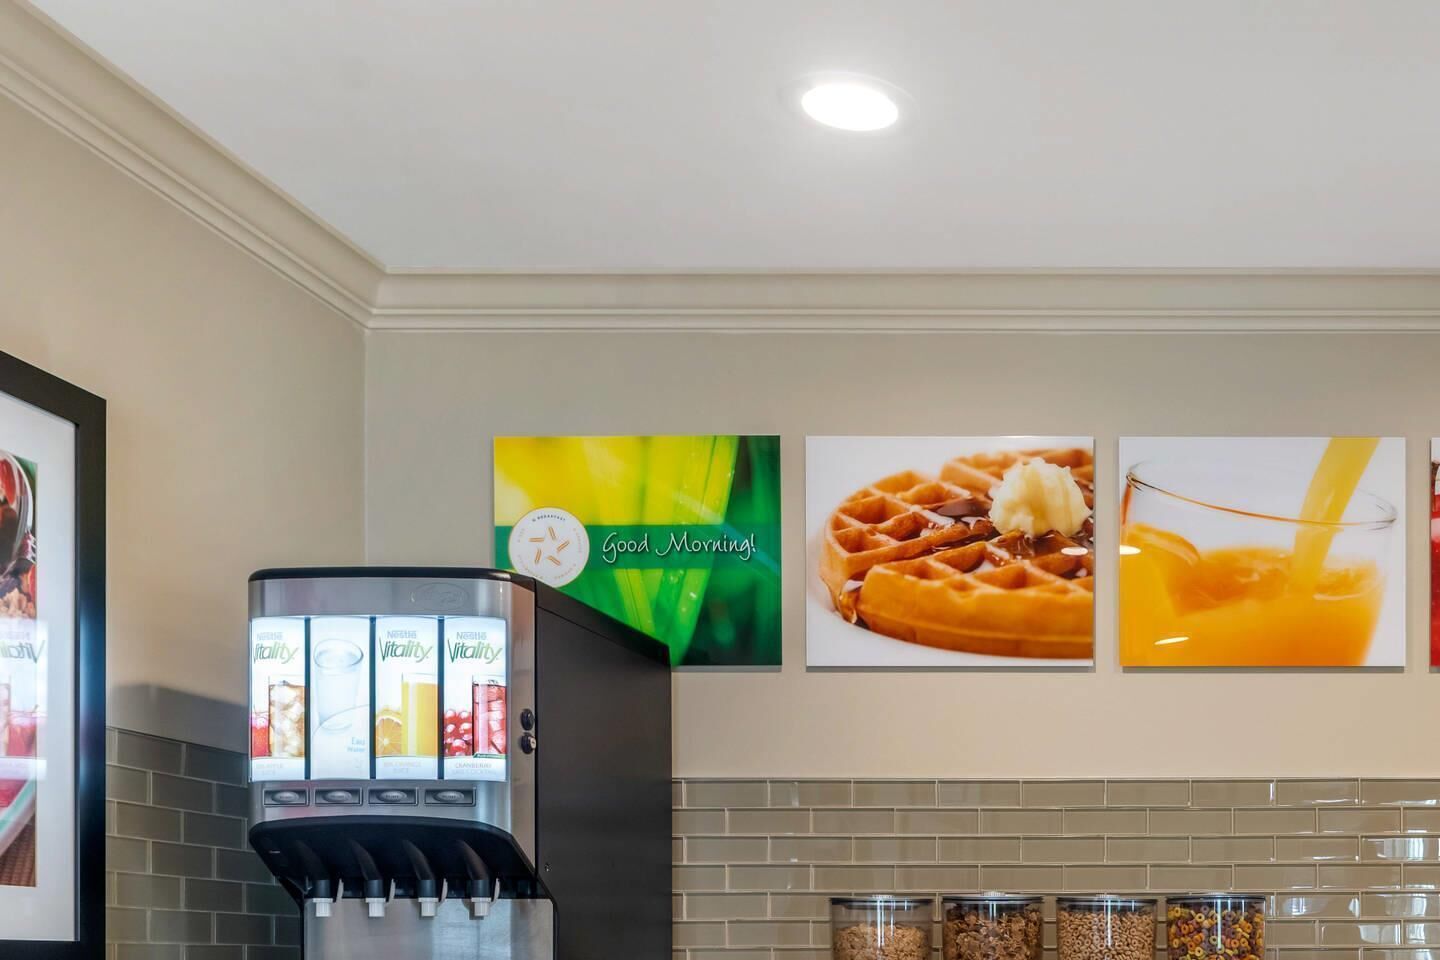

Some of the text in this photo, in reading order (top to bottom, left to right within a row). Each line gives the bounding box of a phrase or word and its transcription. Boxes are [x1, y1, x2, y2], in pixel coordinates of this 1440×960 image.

[602, 531, 649, 563] Good
[655, 531, 757, 561] Morning!
[379, 636, 433, 664] Vitality
[447, 637, 503, 665] Vitality
